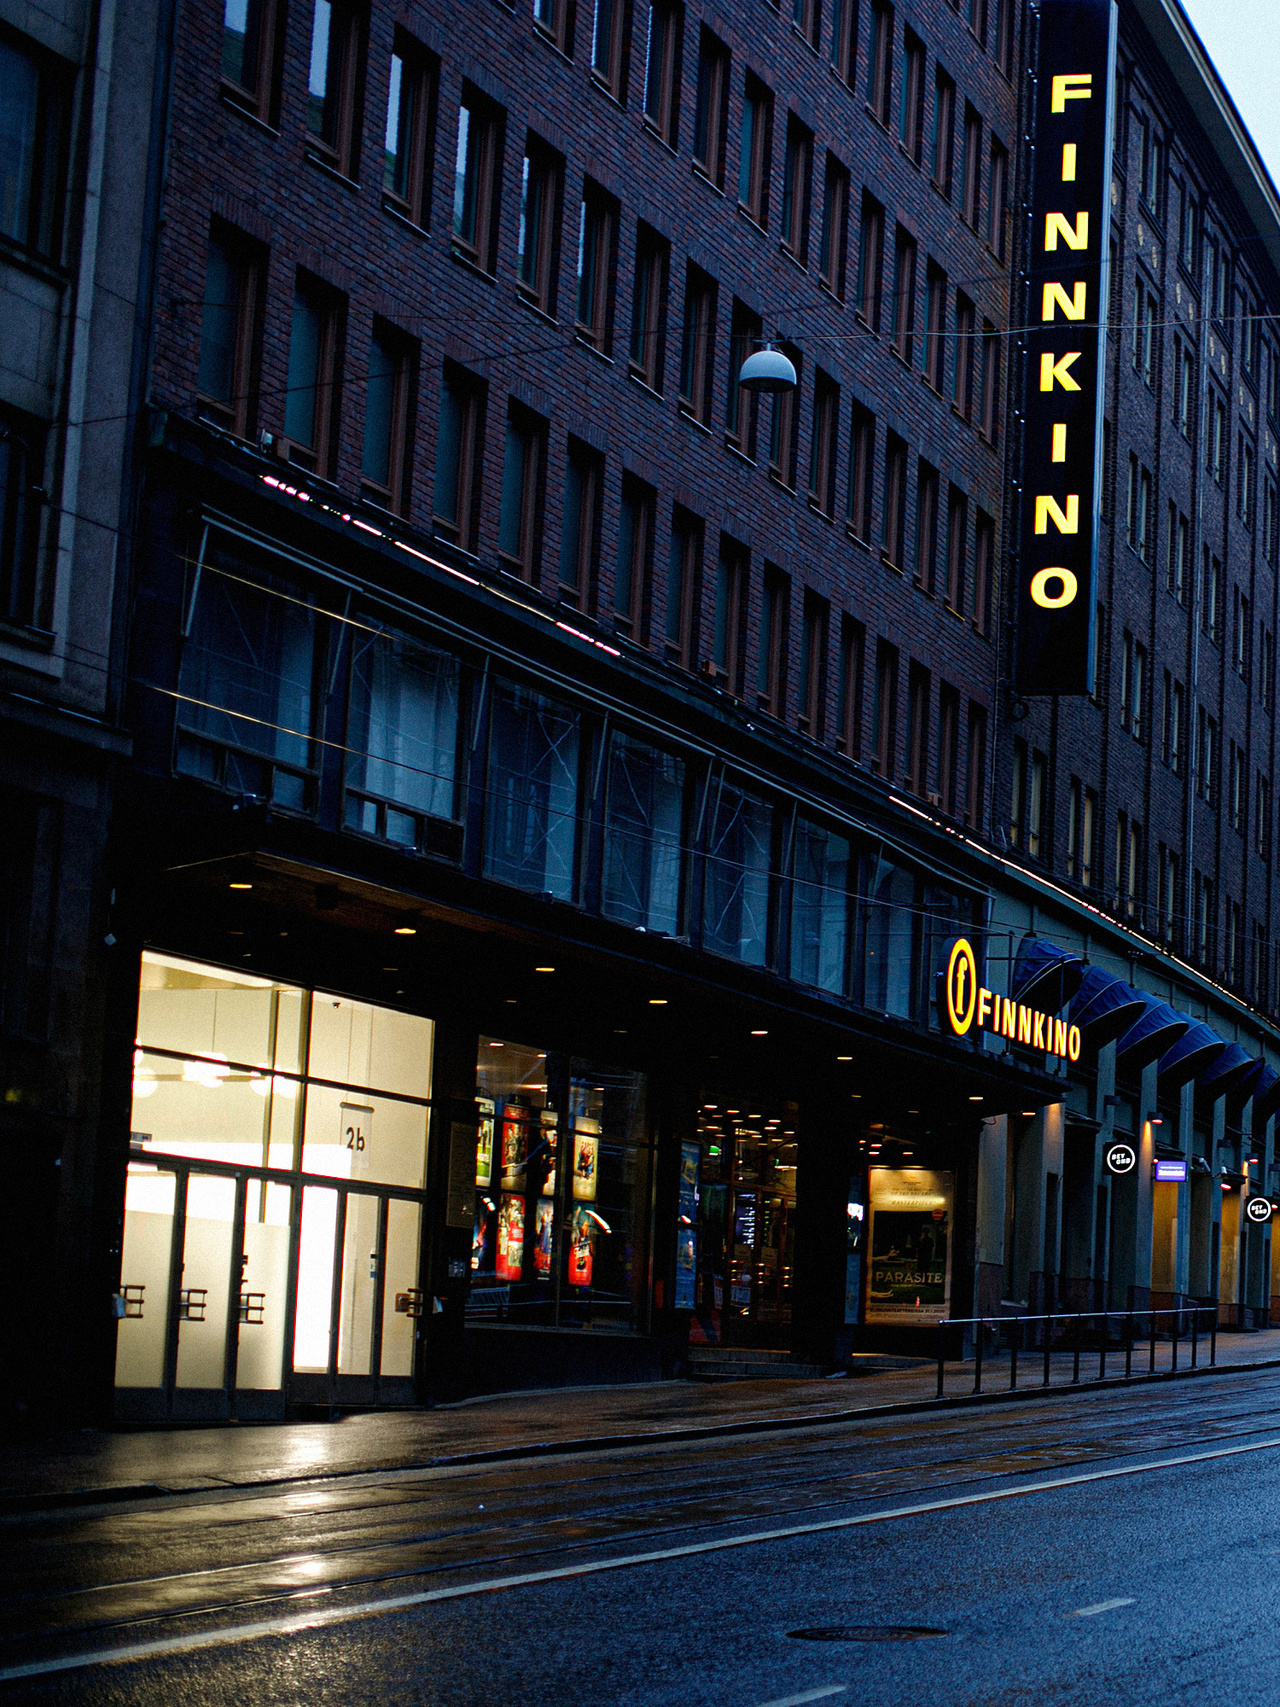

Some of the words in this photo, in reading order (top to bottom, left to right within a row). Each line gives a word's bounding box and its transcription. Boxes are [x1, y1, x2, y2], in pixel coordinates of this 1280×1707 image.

[1030, 72, 1093, 610] FINNKINO
[976, 986, 1082, 1062] FINNKINO
[345, 1126, 366, 1152] 2b
[875, 1271, 943, 1284] PARASITE
